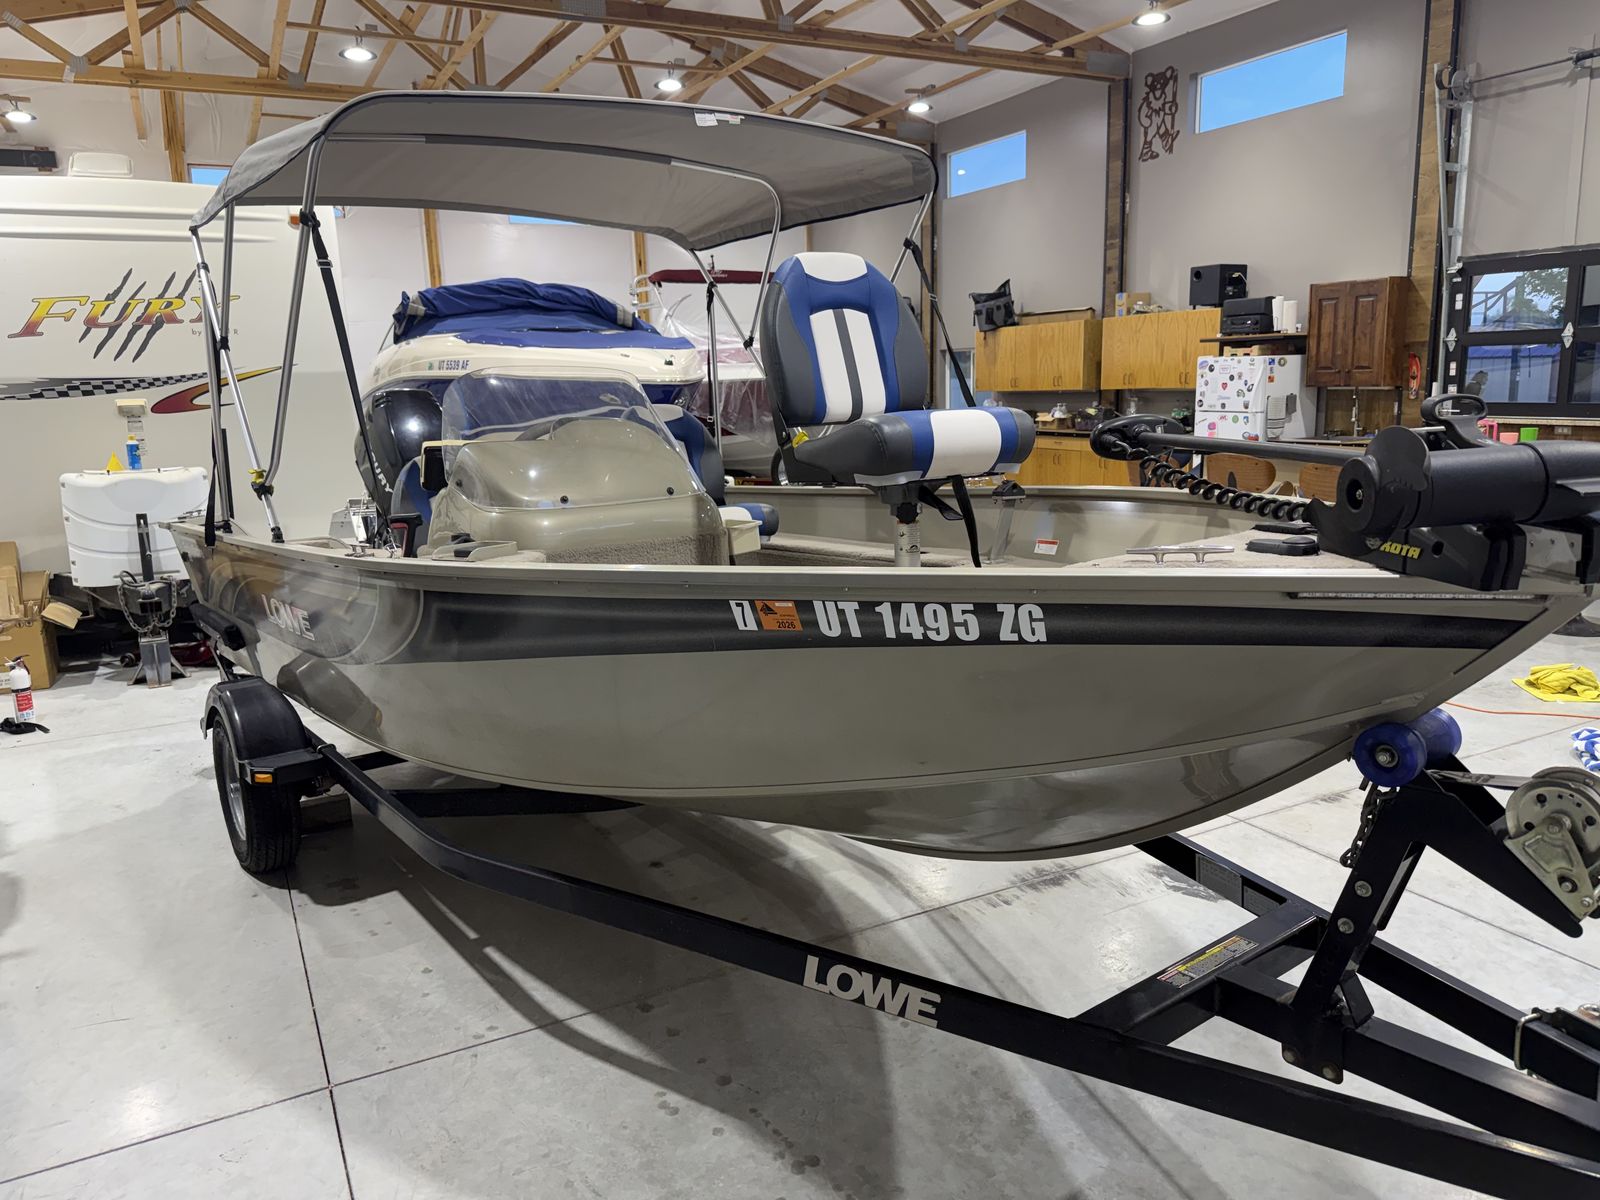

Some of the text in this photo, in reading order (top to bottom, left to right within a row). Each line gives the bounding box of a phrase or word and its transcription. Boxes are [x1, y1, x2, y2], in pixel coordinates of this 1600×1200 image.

[1380, 541, 1421, 559] KOTA
[261, 593, 315, 641] LOWE
[776, 620, 796, 629] 2026
[813, 600, 1047, 642] UT 1495 ZG
[803, 954, 942, 1028] LOWE
